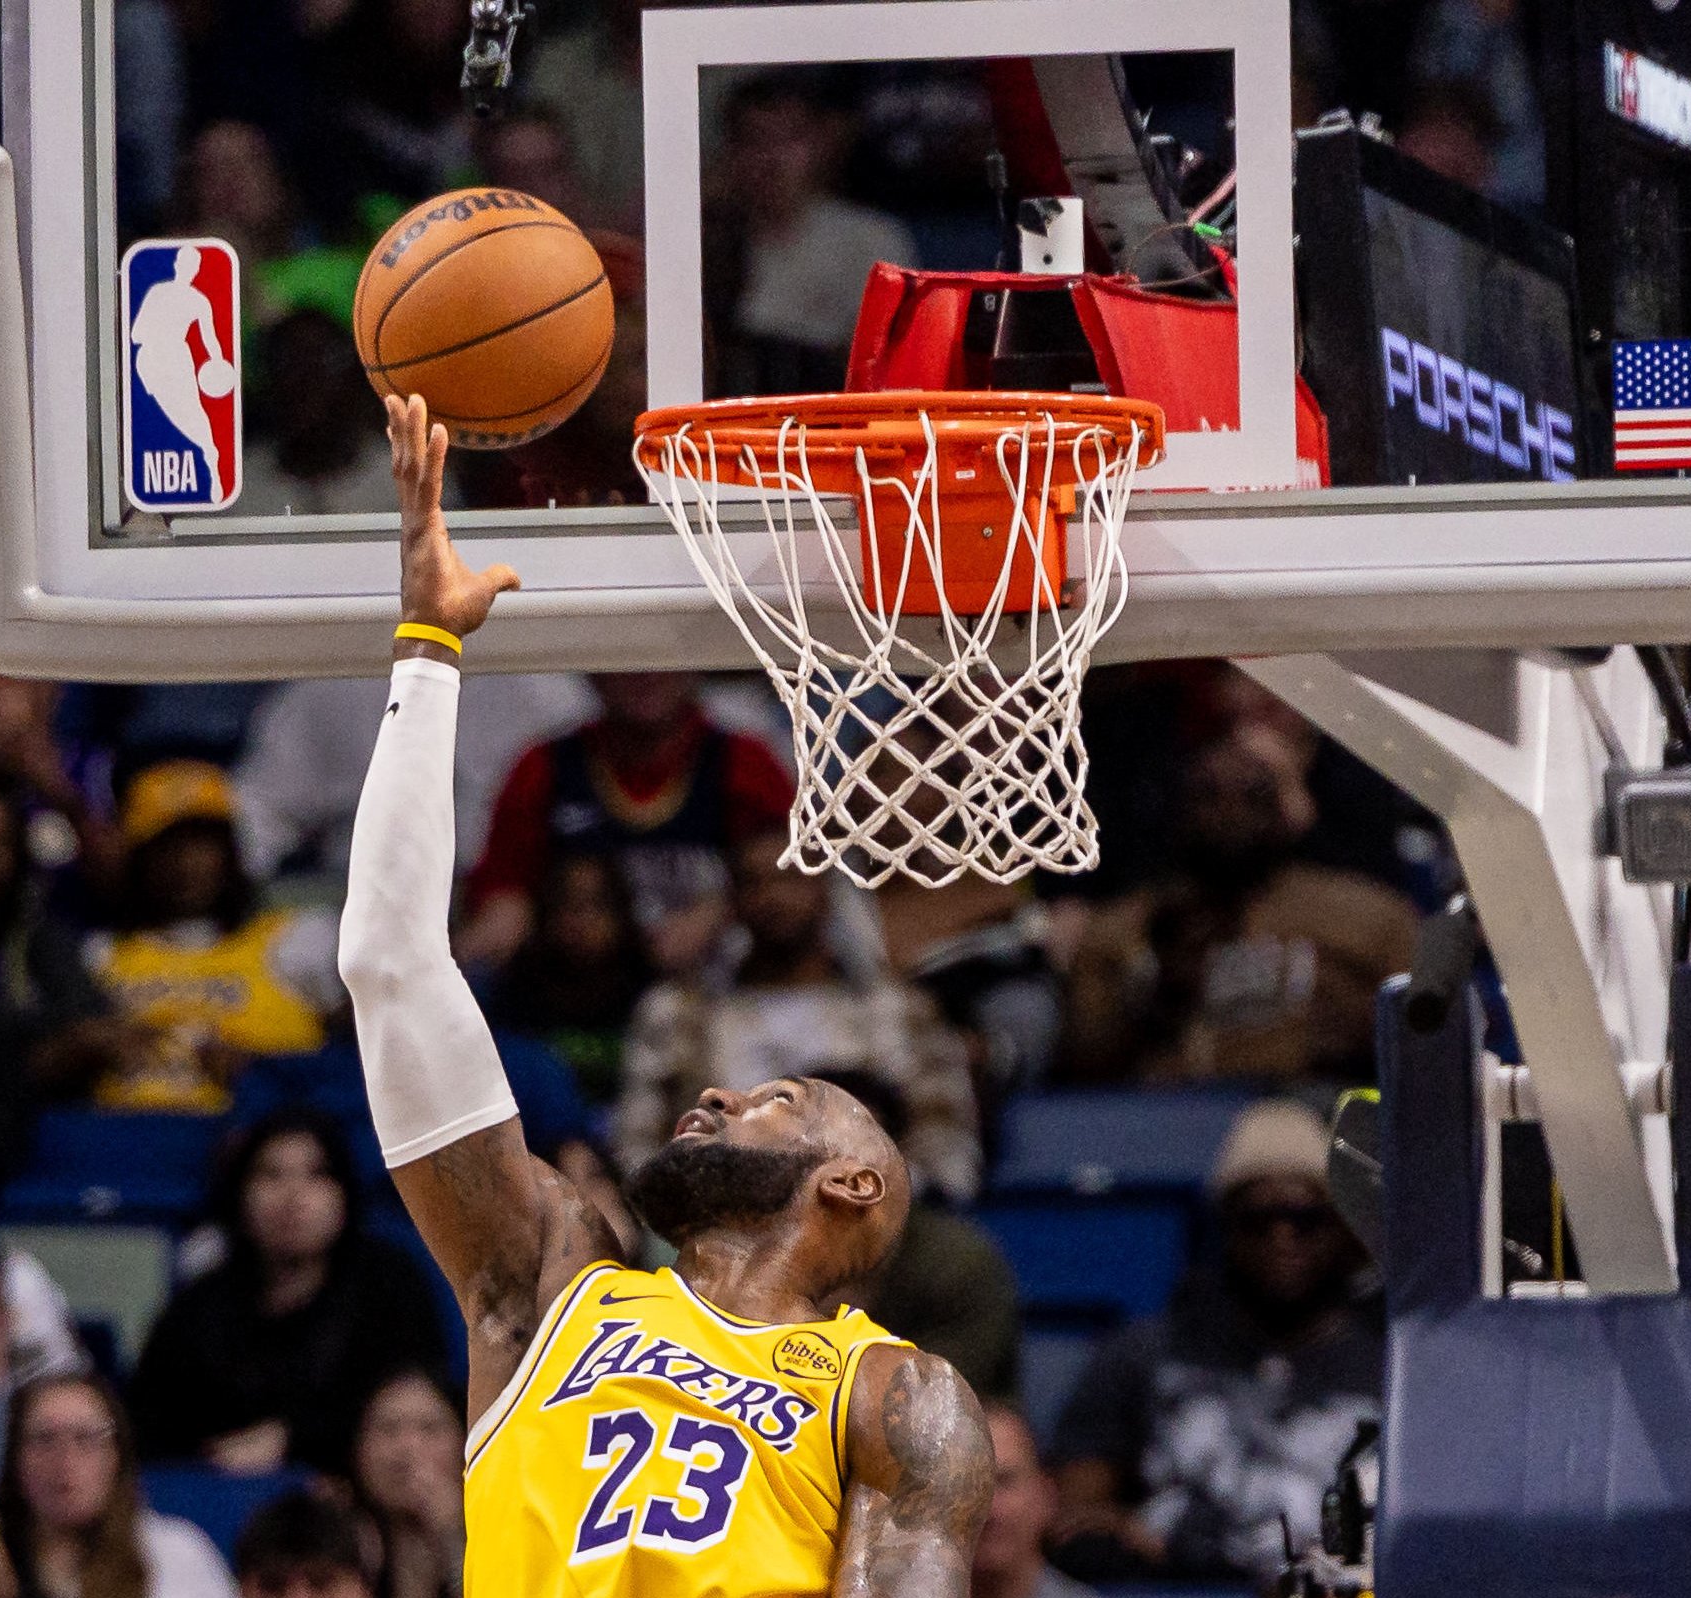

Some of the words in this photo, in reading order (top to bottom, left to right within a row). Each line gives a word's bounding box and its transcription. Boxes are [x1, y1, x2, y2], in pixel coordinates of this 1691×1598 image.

[143, 450, 199, 494] NBA
[1382, 327, 1575, 481] PORSCHE
[538, 1318, 821, 1456] LAKERS
[780, 1338, 838, 1374] bibigo
[566, 1406, 755, 1568] 23
